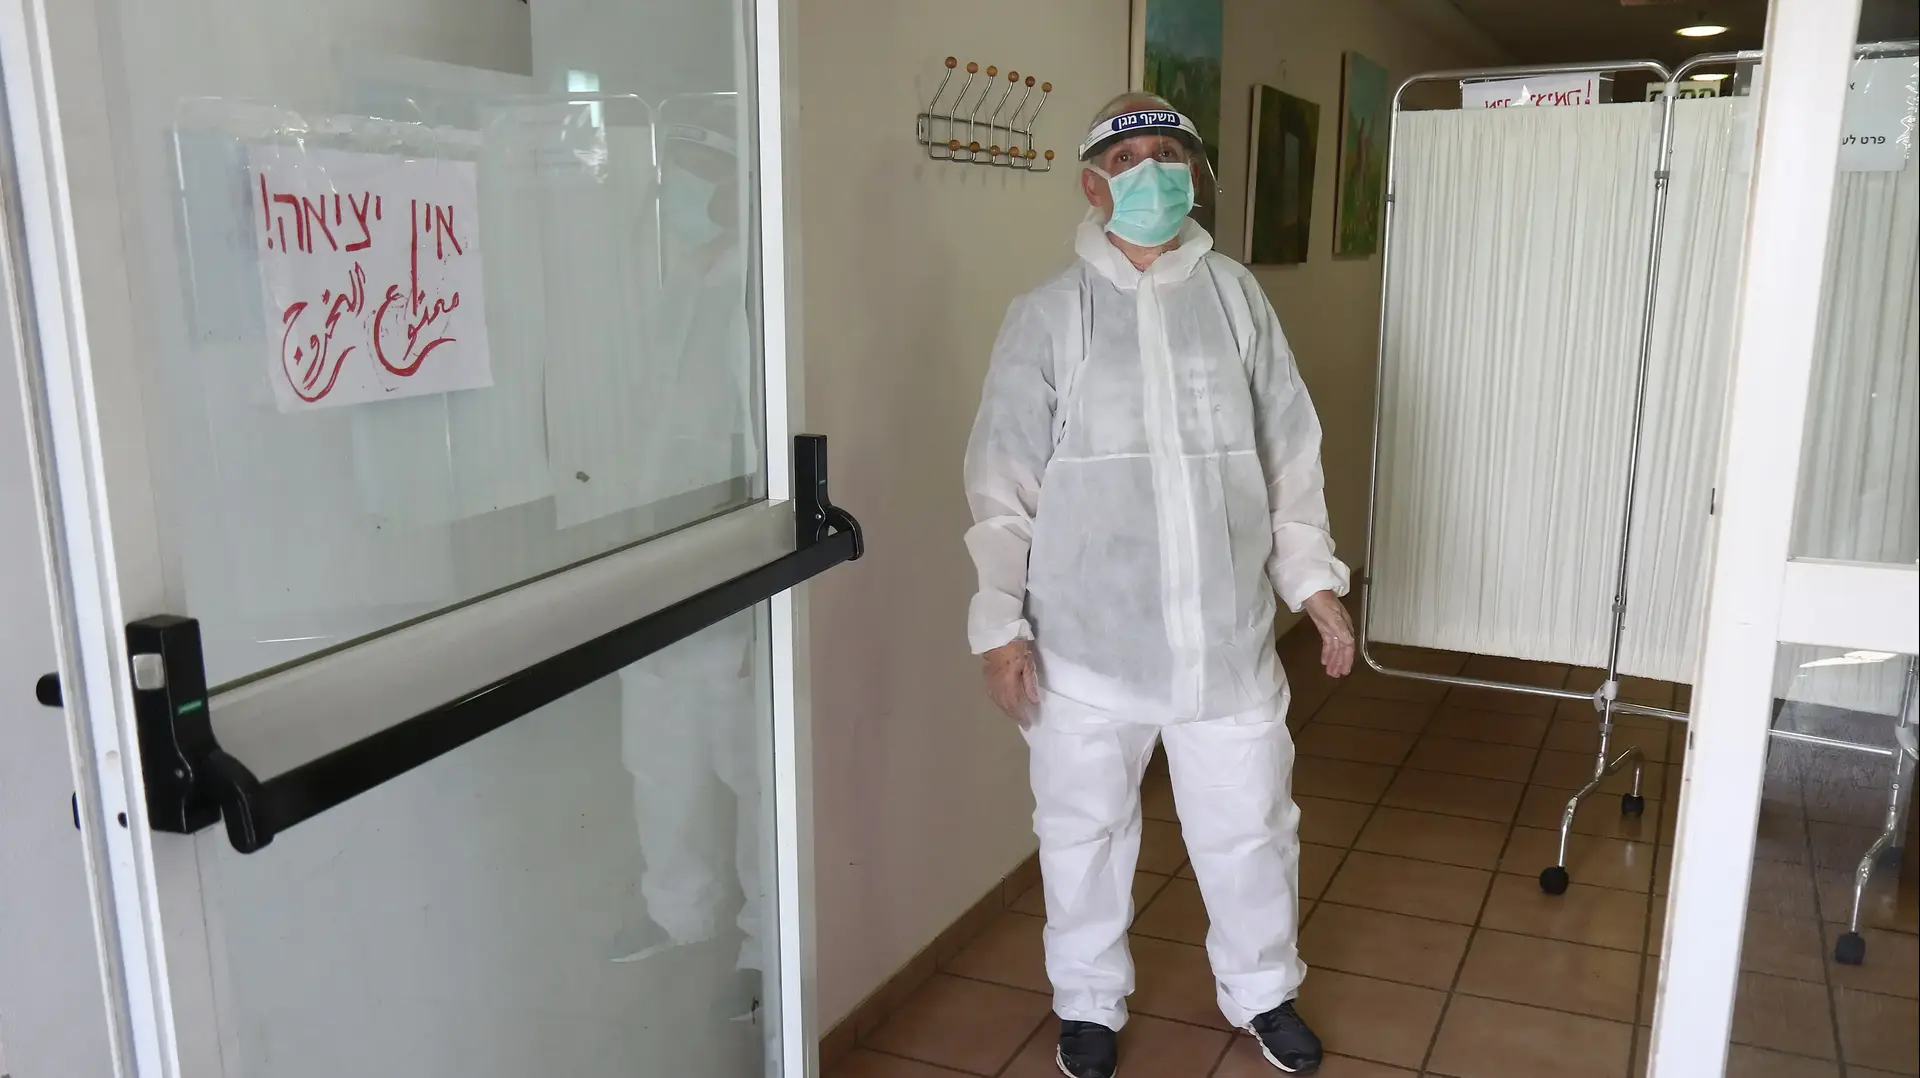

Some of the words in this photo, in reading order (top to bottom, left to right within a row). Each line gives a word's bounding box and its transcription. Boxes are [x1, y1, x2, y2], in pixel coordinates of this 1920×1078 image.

[1118, 114, 1138, 129] מגן
[1139, 112, 1177, 125] משקף
[1860, 135, 1886, 145] פרט
[260, 173, 382, 253] יציאה!
[410, 199, 462, 316] אין
[373, 284, 459, 377] ممنوع
